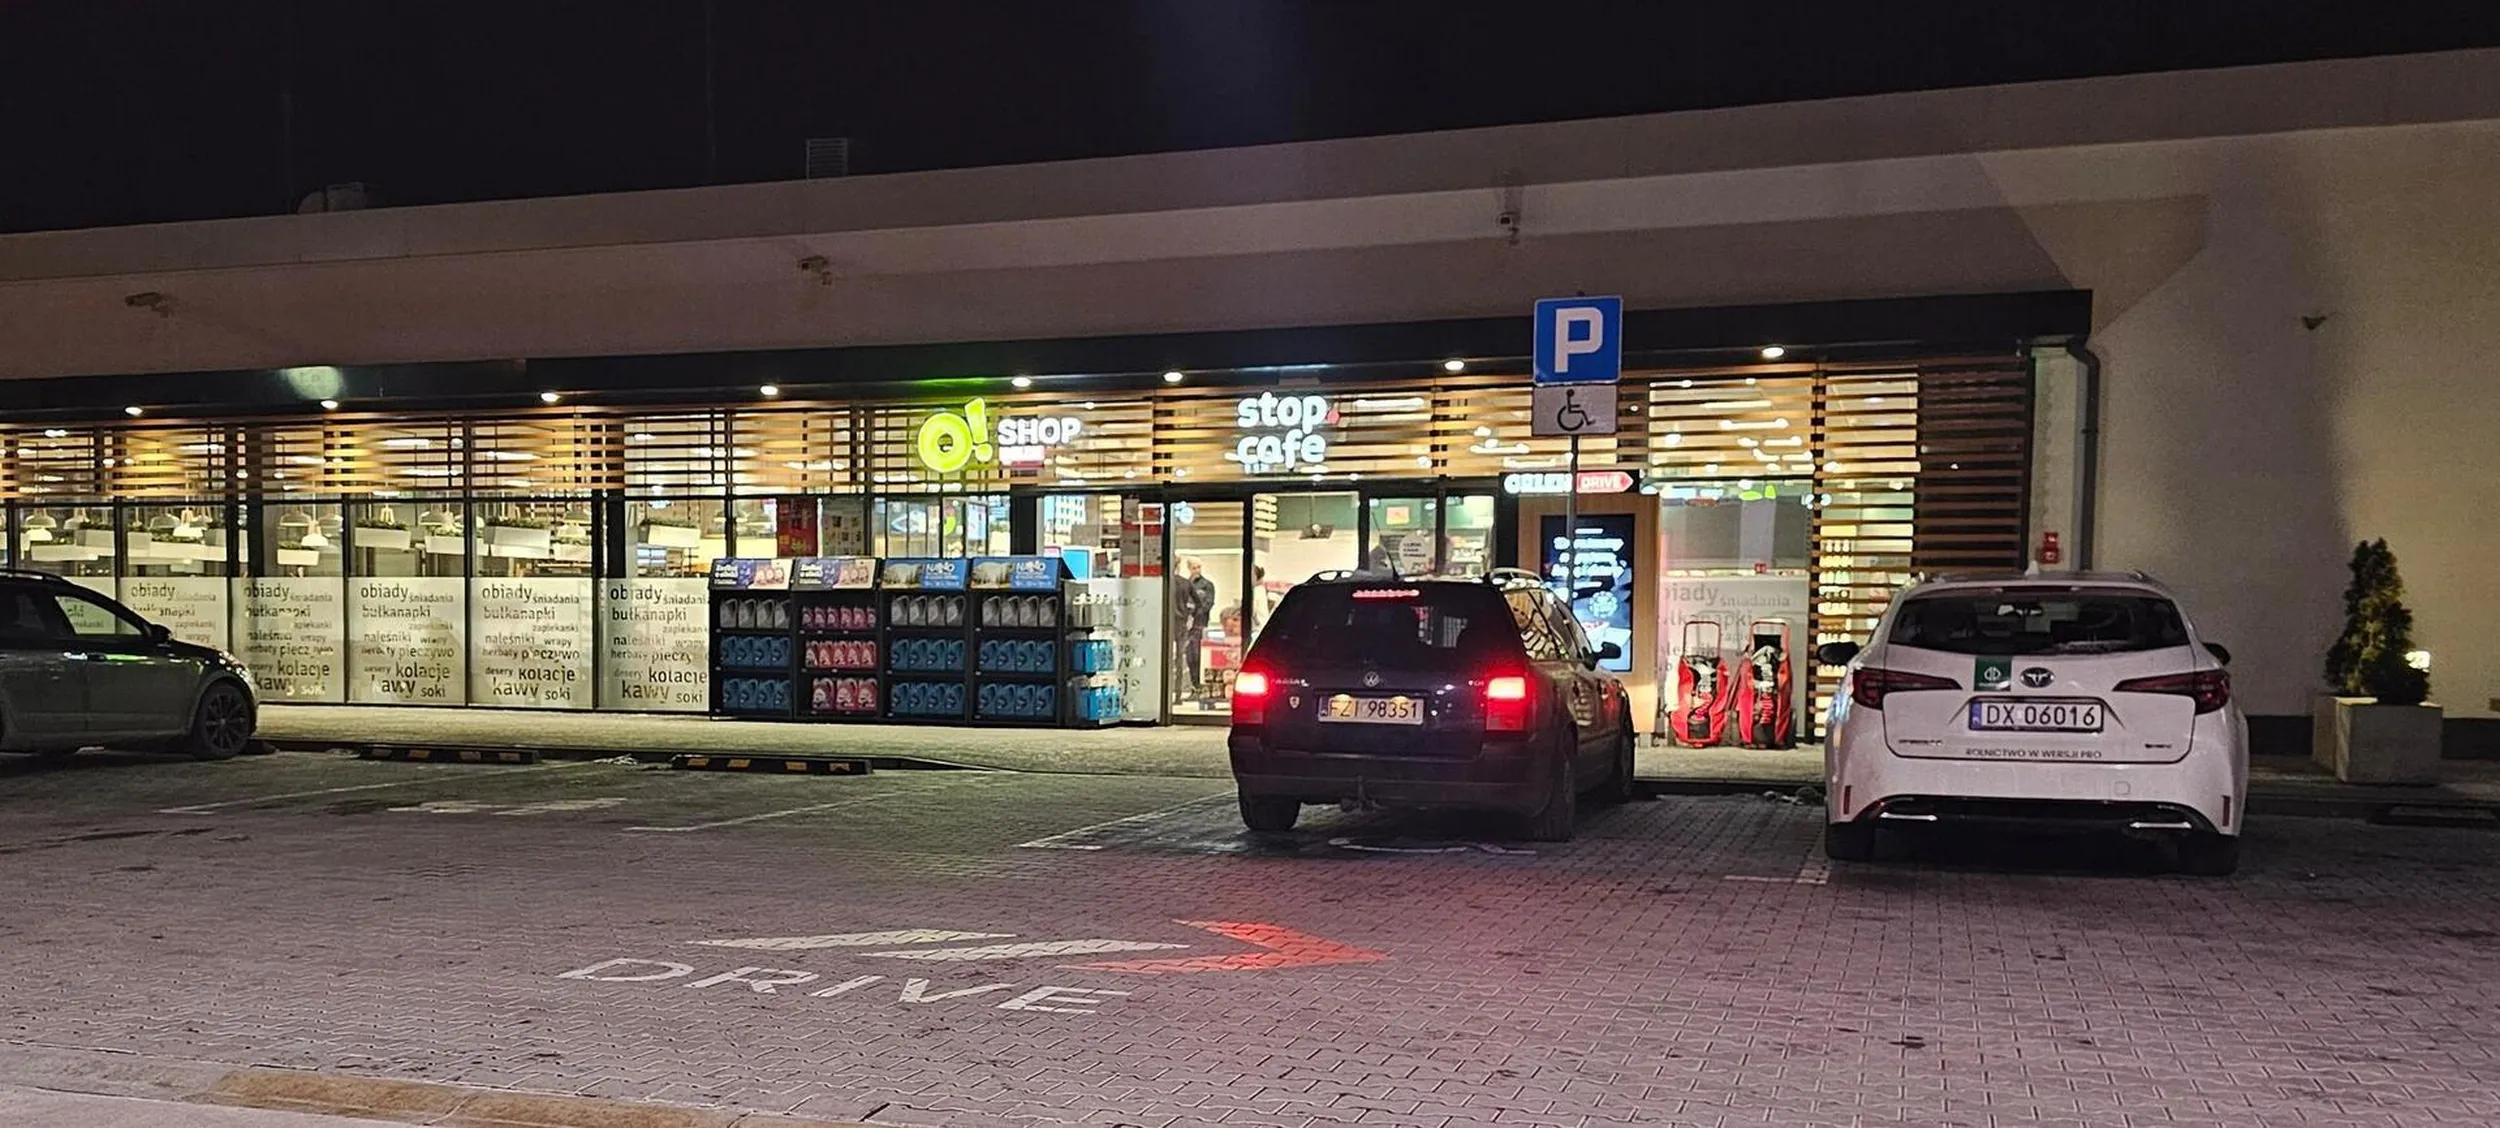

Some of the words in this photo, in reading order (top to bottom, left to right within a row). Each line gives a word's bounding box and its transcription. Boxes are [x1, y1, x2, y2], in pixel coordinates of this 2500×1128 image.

[1554, 307, 1603, 373] P
[998, 417, 1081, 445] SHOP
[1237, 429, 1326, 469] cafe
[1580, 475, 1621, 491] DRIVE
[131, 582, 175, 601] obiady
[244, 583, 290, 601] obiady
[361, 583, 408, 602] obiady
[482, 583, 532, 603] obiady
[533, 594, 580, 604] śniadania
[610, 583, 662, 604] obiady
[1720, 594, 1791, 607] śniadania
[612, 606, 687, 624] bułkanapki
[485, 632, 535, 644] naleśniki
[399, 645, 455, 661] pieczywo
[277, 660, 330, 679] kolacje
[396, 661, 451, 682] kolacje
[519, 665, 575, 685] kolacje
[649, 666, 708, 684] kolacje
[254, 672, 297, 696] kawy
[420, 683, 446, 698] soki
[493, 676, 540, 698] kawy
[545, 686, 571, 701] soki
[622, 679, 671, 704] kawy
[676, 689, 703, 703] soki
[1329, 700, 1358, 717] FZI
[1367, 701, 1417, 719] 98351
[1987, 705, 2014, 724] DX
[2024, 706, 2095, 726] 06016
[1966, 748, 2026, 757] ROLNICTWO
[2029, 749, 2039, 757] W
[2041, 750, 2079, 758] WERSJI
[2081, 750, 2102, 759] PRO
[555, 957, 1132, 1013] DRIVE
